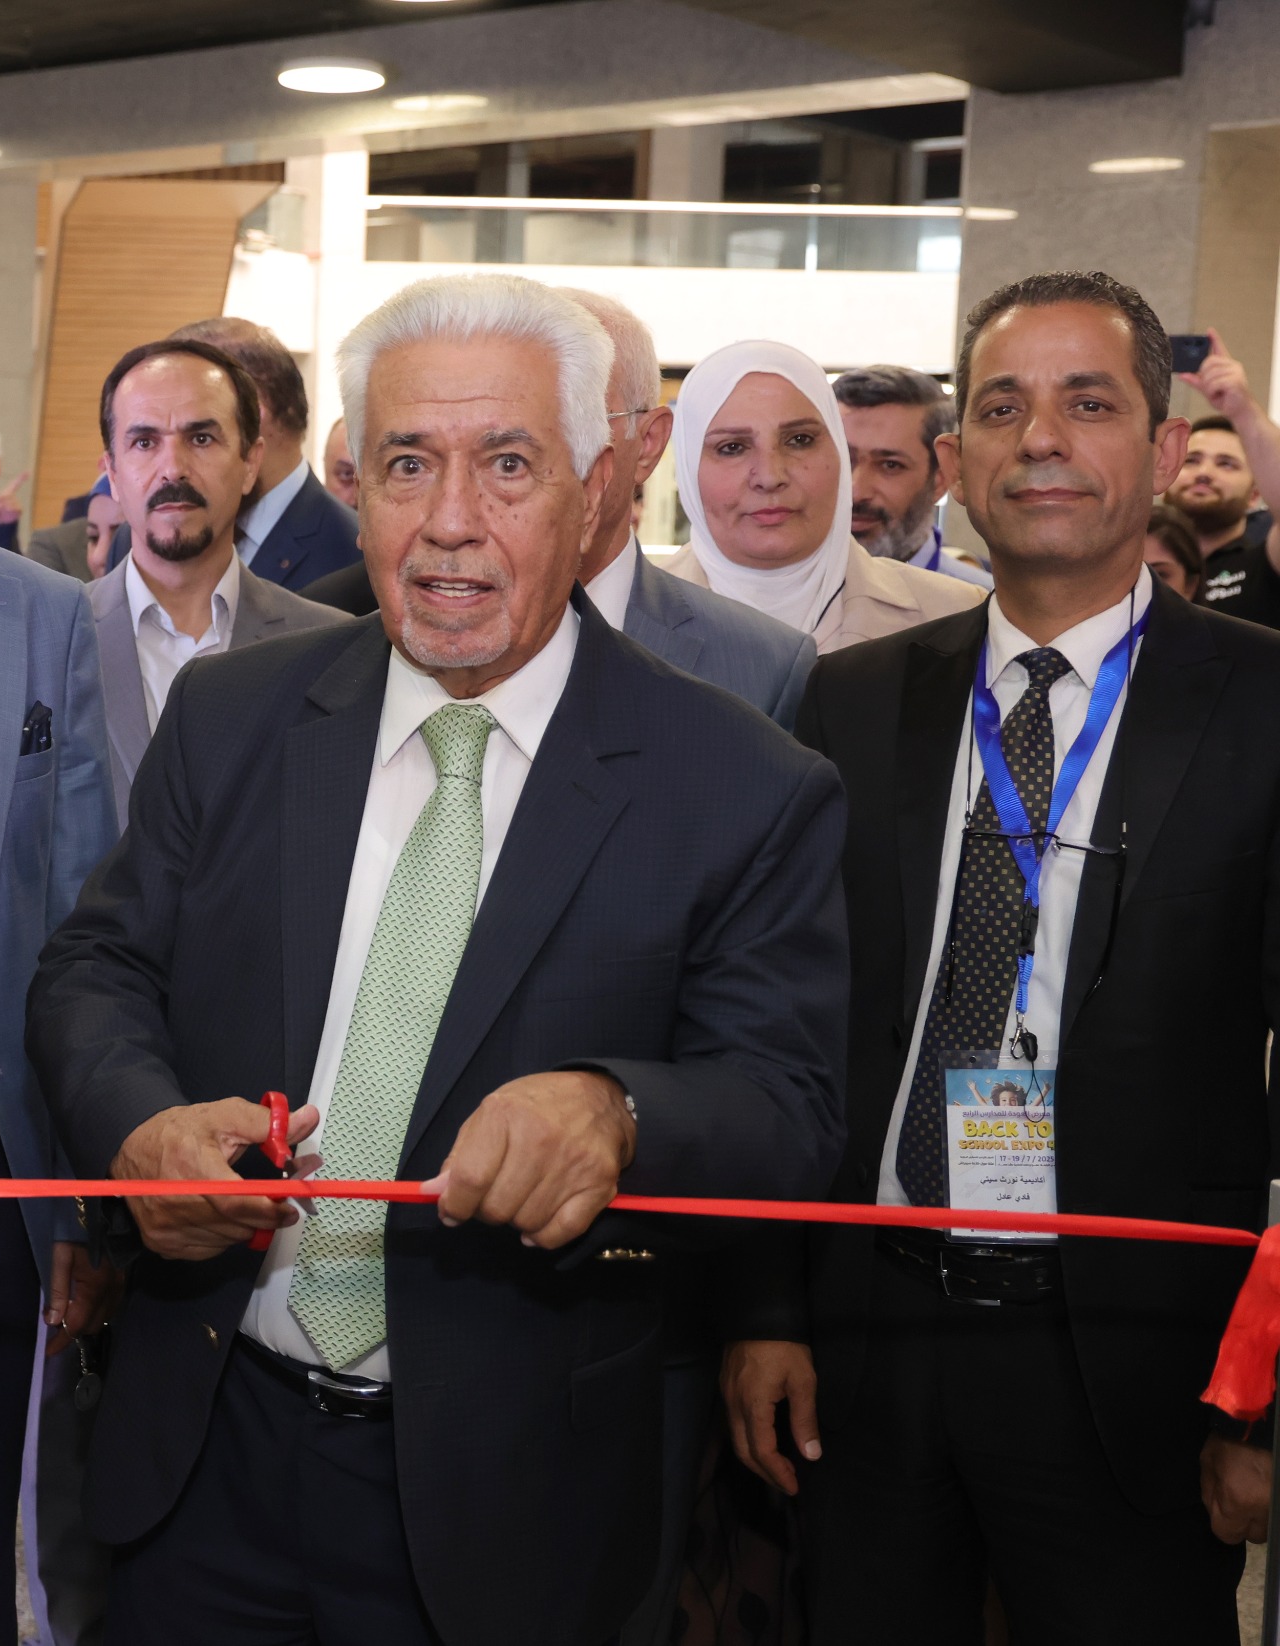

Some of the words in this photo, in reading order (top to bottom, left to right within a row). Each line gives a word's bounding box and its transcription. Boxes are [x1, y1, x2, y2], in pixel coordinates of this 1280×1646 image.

[962, 1110, 979, 1118] الرابع
[980, 1110, 1007, 1118] للمدارس
[1008, 1110, 1030, 1119] العودة
[963, 1119, 1019, 1137] BACK
[1023, 1120, 1053, 1138] TO
[958, 1140, 1009, 1150] SCHOOL
[1011, 1140, 1045, 1151] EXPO
[1037, 1155, 1055, 1163] 2025
[980, 1176, 998, 1185] سيتي
[1000, 1175, 1018, 1185] نورث
[1020, 1175, 1046, 1185] أكاديمية
[997, 1193, 1012, 1202] عادل
[1014, 1192, 1030, 1202] فادي
